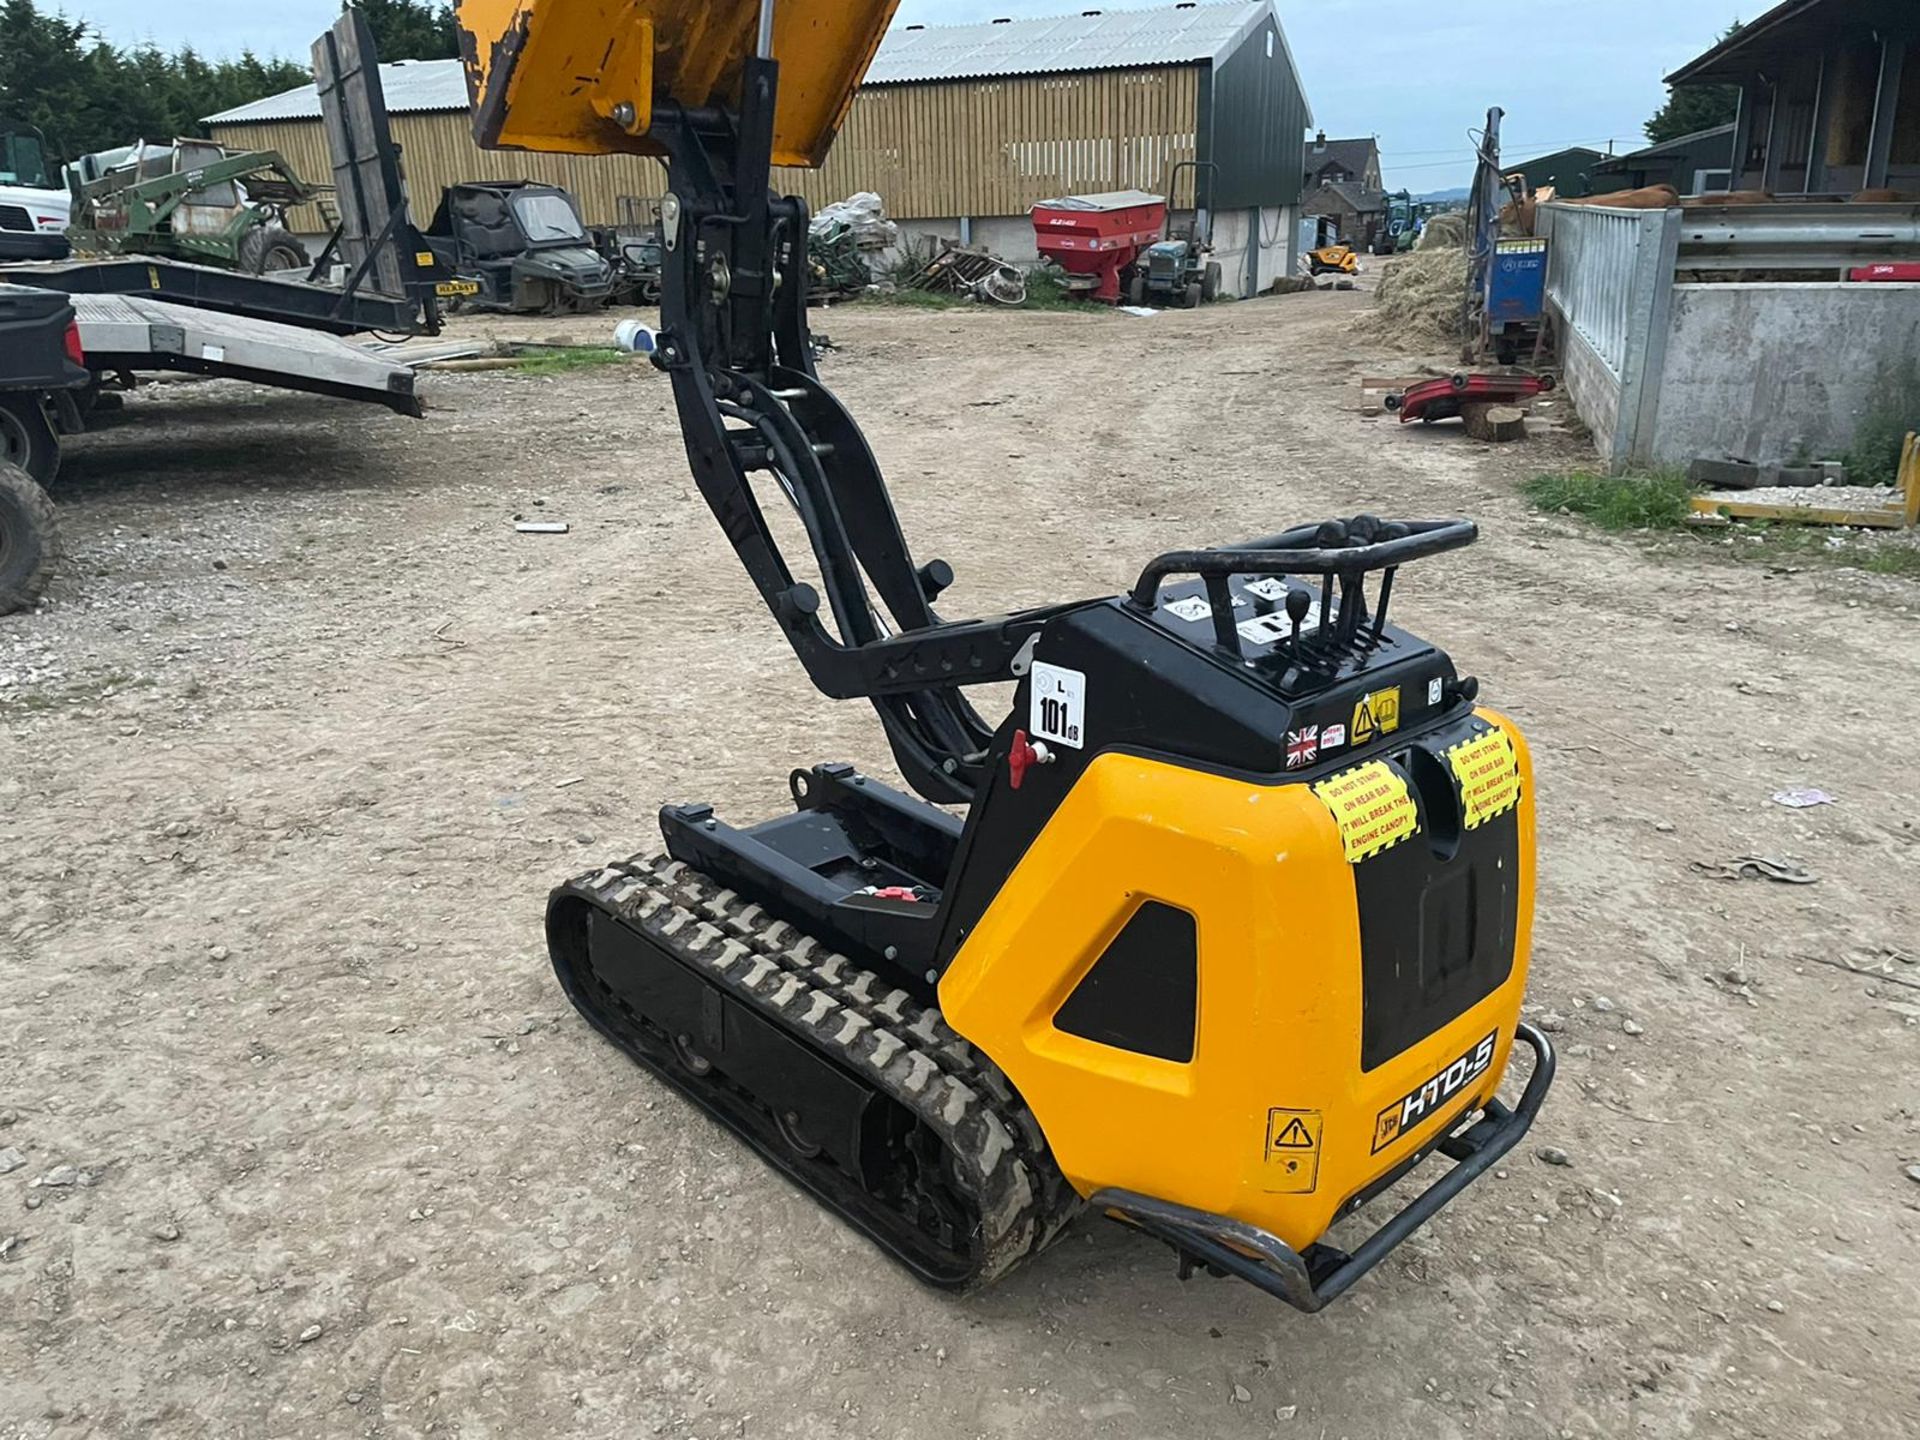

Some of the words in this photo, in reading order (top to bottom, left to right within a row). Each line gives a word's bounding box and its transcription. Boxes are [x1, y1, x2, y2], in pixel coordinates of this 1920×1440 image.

[1058, 680, 1065, 693] L
[1041, 697, 1067, 738] 101
[1068, 724, 1078, 741] dB
[1460, 755, 1470, 765] DO
[1470, 750, 1482, 760] NOT
[1482, 741, 1500, 754] STAND
[1469, 770, 1478, 780] ON
[1478, 762, 1494, 773] REAR
[1493, 756, 1504, 768] BAR
[1329, 788, 1342, 798] DO
[1342, 780, 1357, 792] NOT
[1356, 771, 1381, 786] STAND
[1344, 802, 1356, 812] ON
[1356, 791, 1376, 806] REAR
[1375, 784, 1391, 796] BAR
[1472, 784, 1486, 796] WILL
[1486, 775, 1504, 790] BREAK
[1492, 786, 1512, 803] CANOPY
[1343, 824, 1350, 834] IT
[1350, 816, 1370, 830] WILL
[1368, 804, 1394, 820] BREAK
[1394, 795, 1408, 808] THE
[1352, 828, 1380, 849] ENGINE
[1380, 814, 1408, 834] CANOPY
[1401, 1034, 1494, 1126] HTD-5
